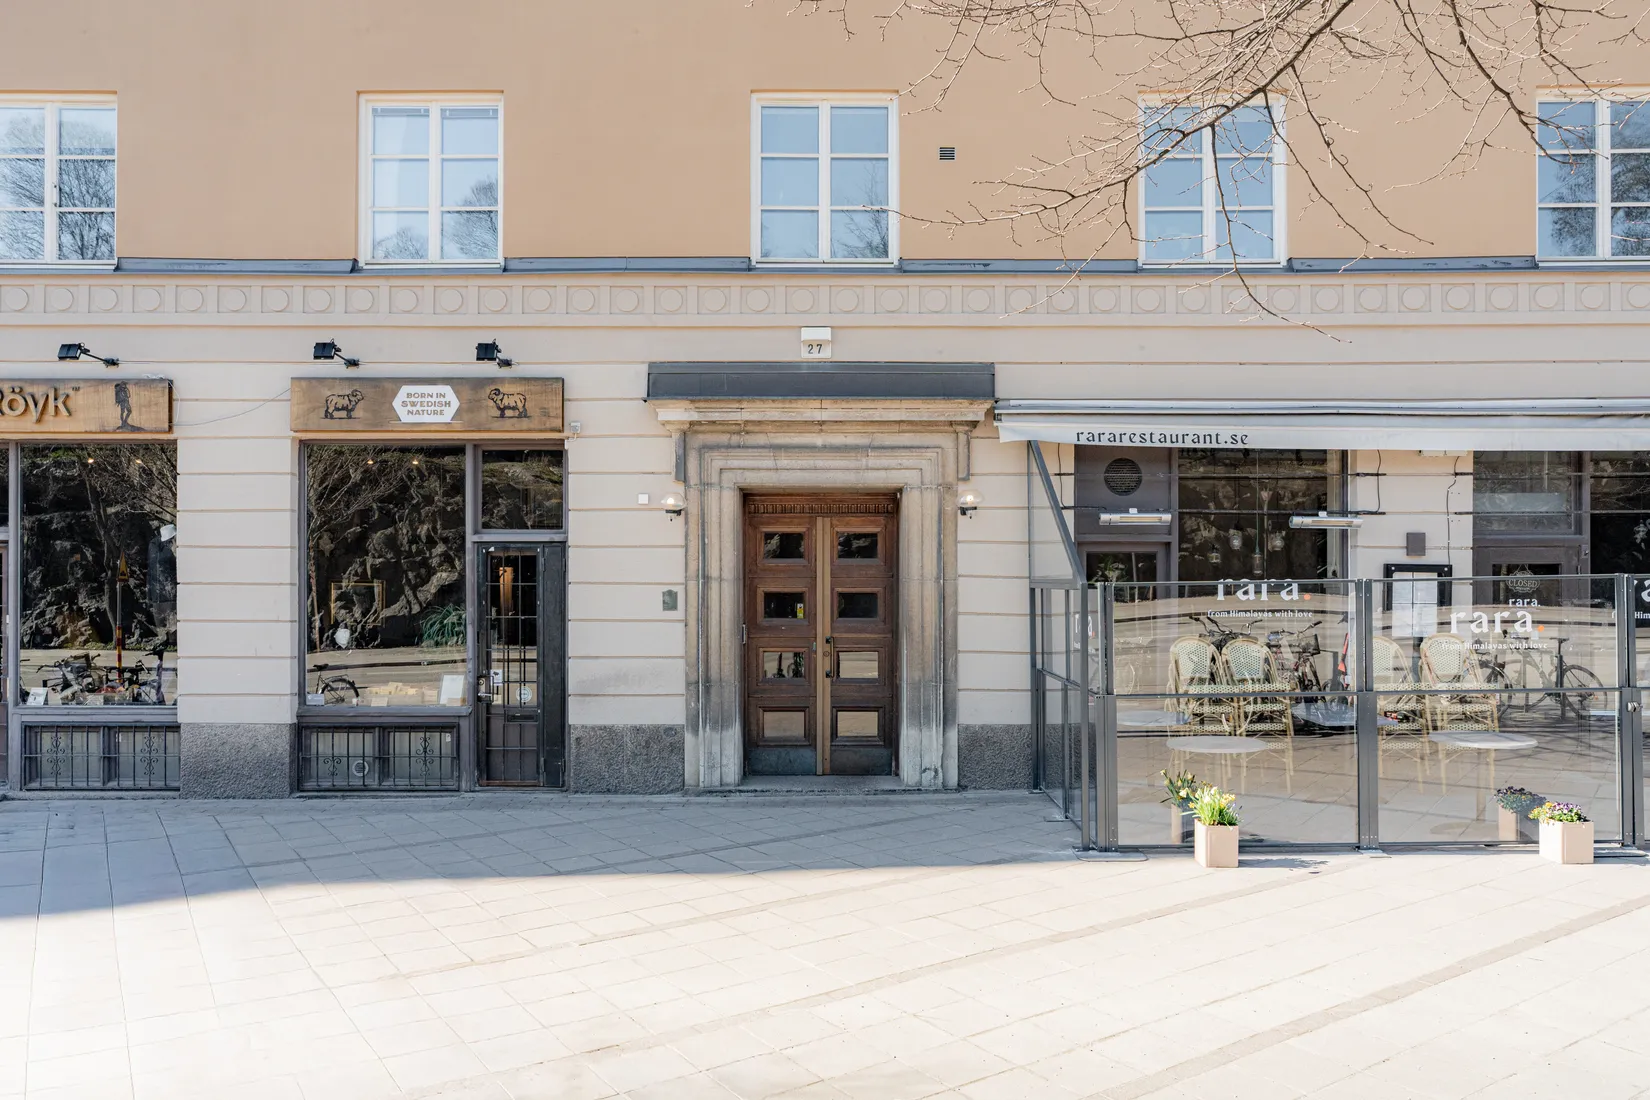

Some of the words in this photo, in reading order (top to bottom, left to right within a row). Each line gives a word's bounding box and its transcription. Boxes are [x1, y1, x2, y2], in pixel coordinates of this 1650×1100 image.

[808, 344, 822, 354] 27
[0, 386, 71, 424] öyk
[1076, 431, 1249, 445] rararestaurant.se
[1508, 579, 1538, 588] CLOSED
[1230, 610, 1272, 618] Himalayas
[1464, 641, 1508, 650] Himalayas
[1510, 641, 1528, 649] with
